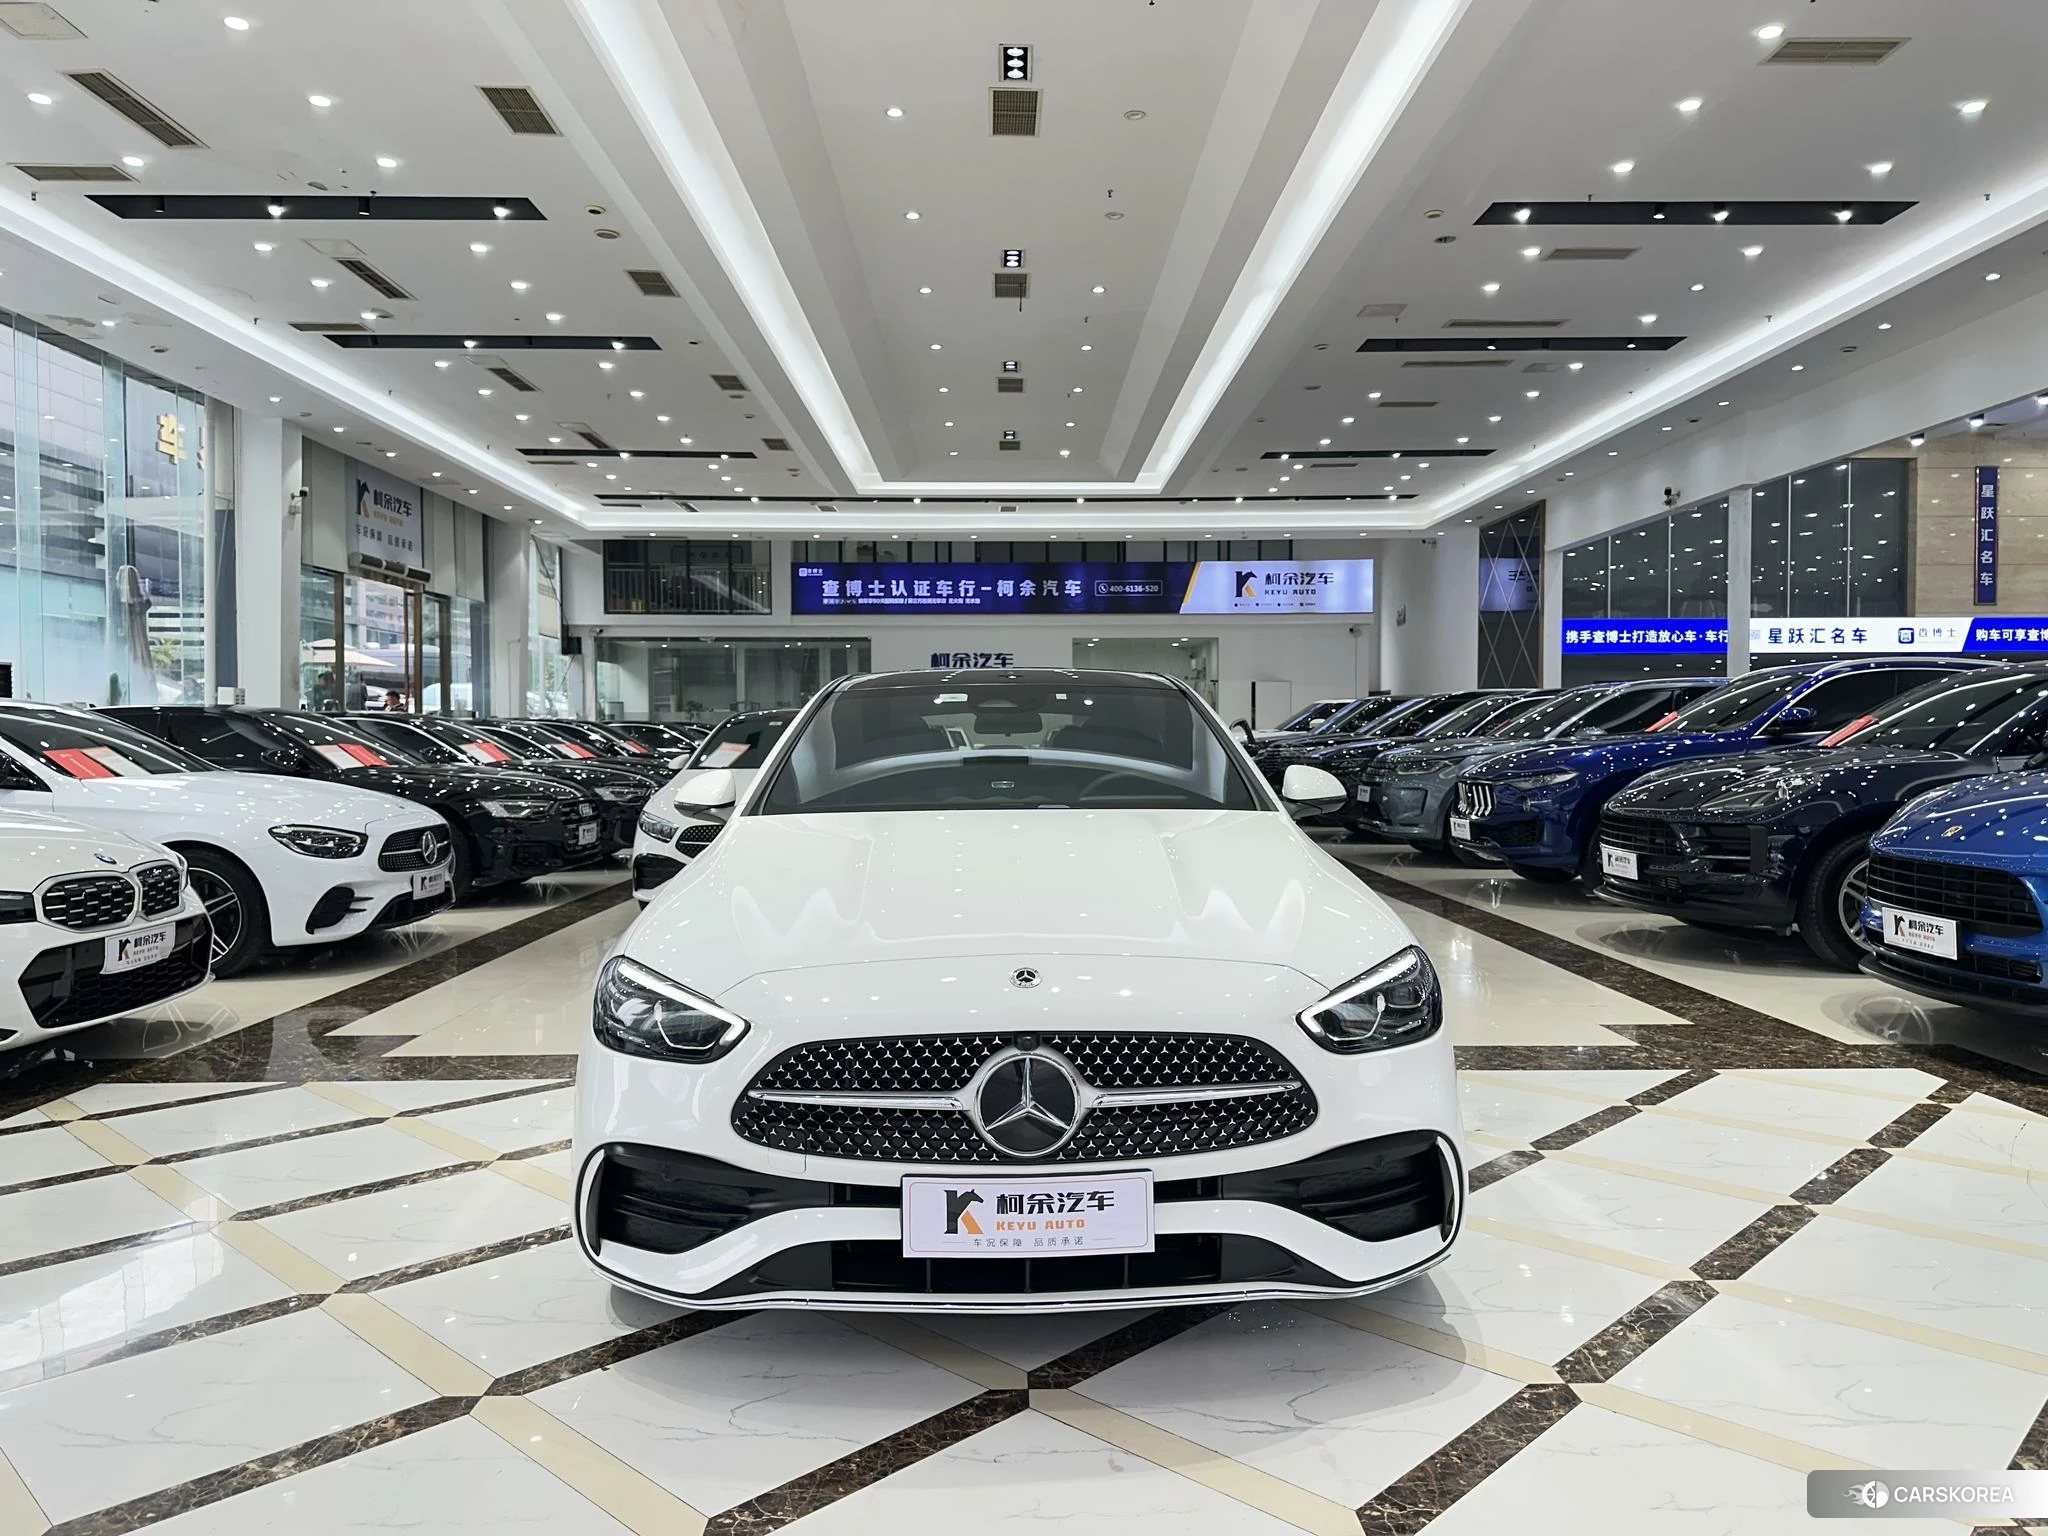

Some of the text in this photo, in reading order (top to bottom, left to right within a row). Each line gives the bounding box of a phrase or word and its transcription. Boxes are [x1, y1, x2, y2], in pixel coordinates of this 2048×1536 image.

[373, 488, 413, 517] 柯余汽车
[1979, 484, 1995, 586] 星跃汇名车
[1264, 572, 1335, 586] 柯余汽车
[1109, 585, 1159, 593] 400-6136-520
[1768, 627, 1868, 644] 星跃汇名车
[930, 652, 1014, 669] 柯余汽车
[1908, 919, 1945, 936] 柯余汽车
[134, 931, 167, 949] 柯余汽车
[996, 1190, 1115, 1215] 柯余汽车
[996, 1218, 1086, 1231] KEYU AUTO
[973, 1236, 1084, 1248] 车况保障 品质承诺
